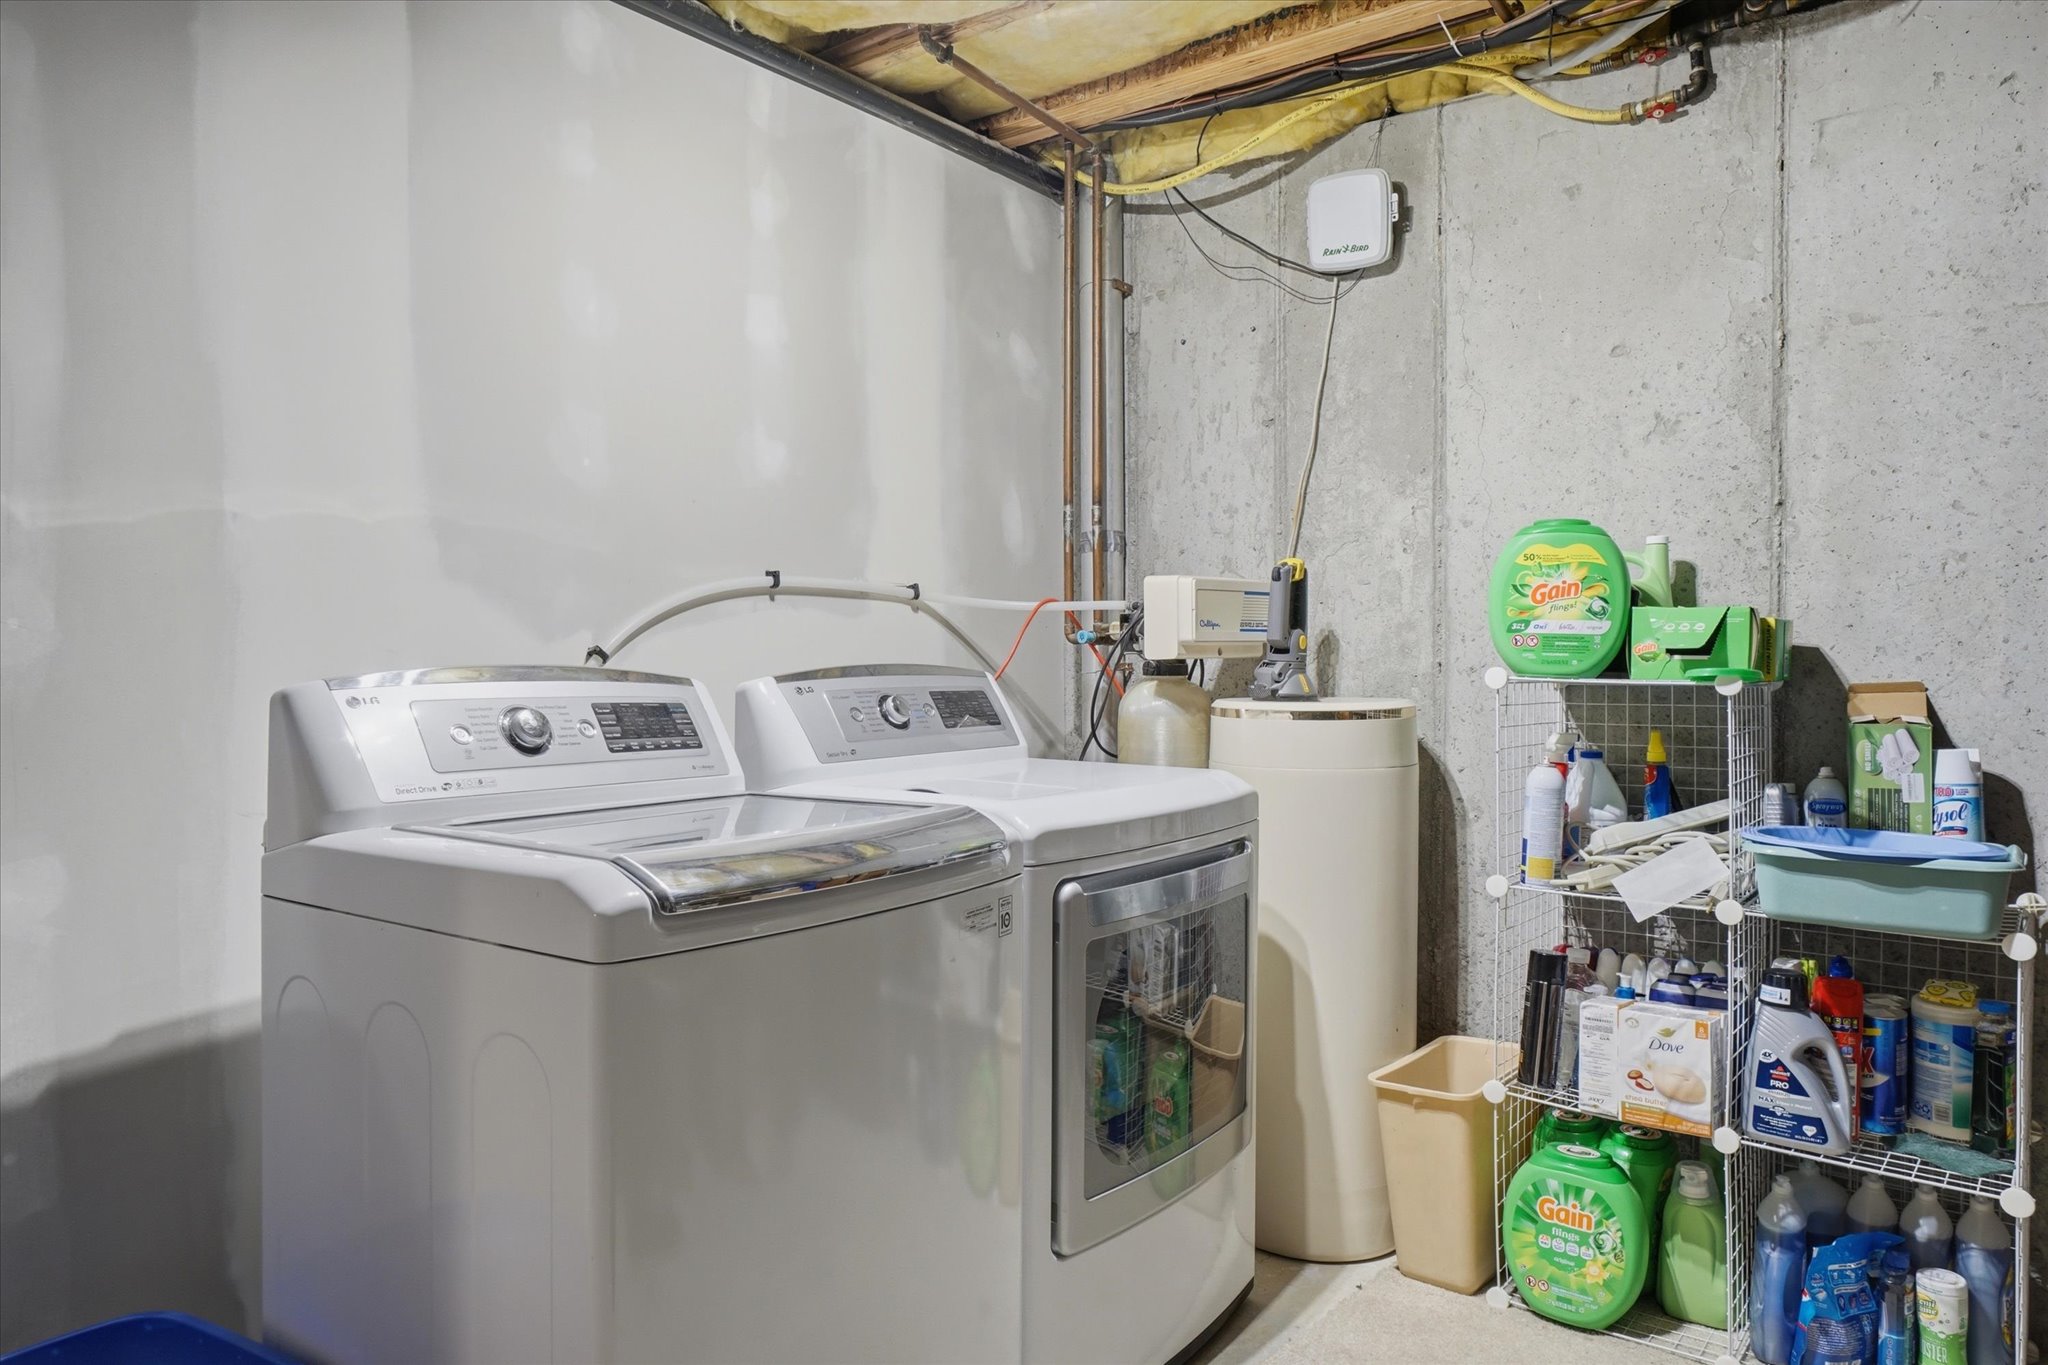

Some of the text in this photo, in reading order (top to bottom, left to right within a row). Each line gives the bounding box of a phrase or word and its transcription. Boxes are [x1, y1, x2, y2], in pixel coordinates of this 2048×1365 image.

[1323, 245, 1369, 257] RAIN BIRD
[1531, 580, 1582, 606] Gain
[363, 697, 380, 705] LG
[395, 786, 417, 795] Direct
[418, 785, 437, 793] Drive
[1649, 1037, 1684, 1054] Dove
[1770, 1080, 1789, 1089] PRO
[1538, 1197, 1592, 1232] Gain
